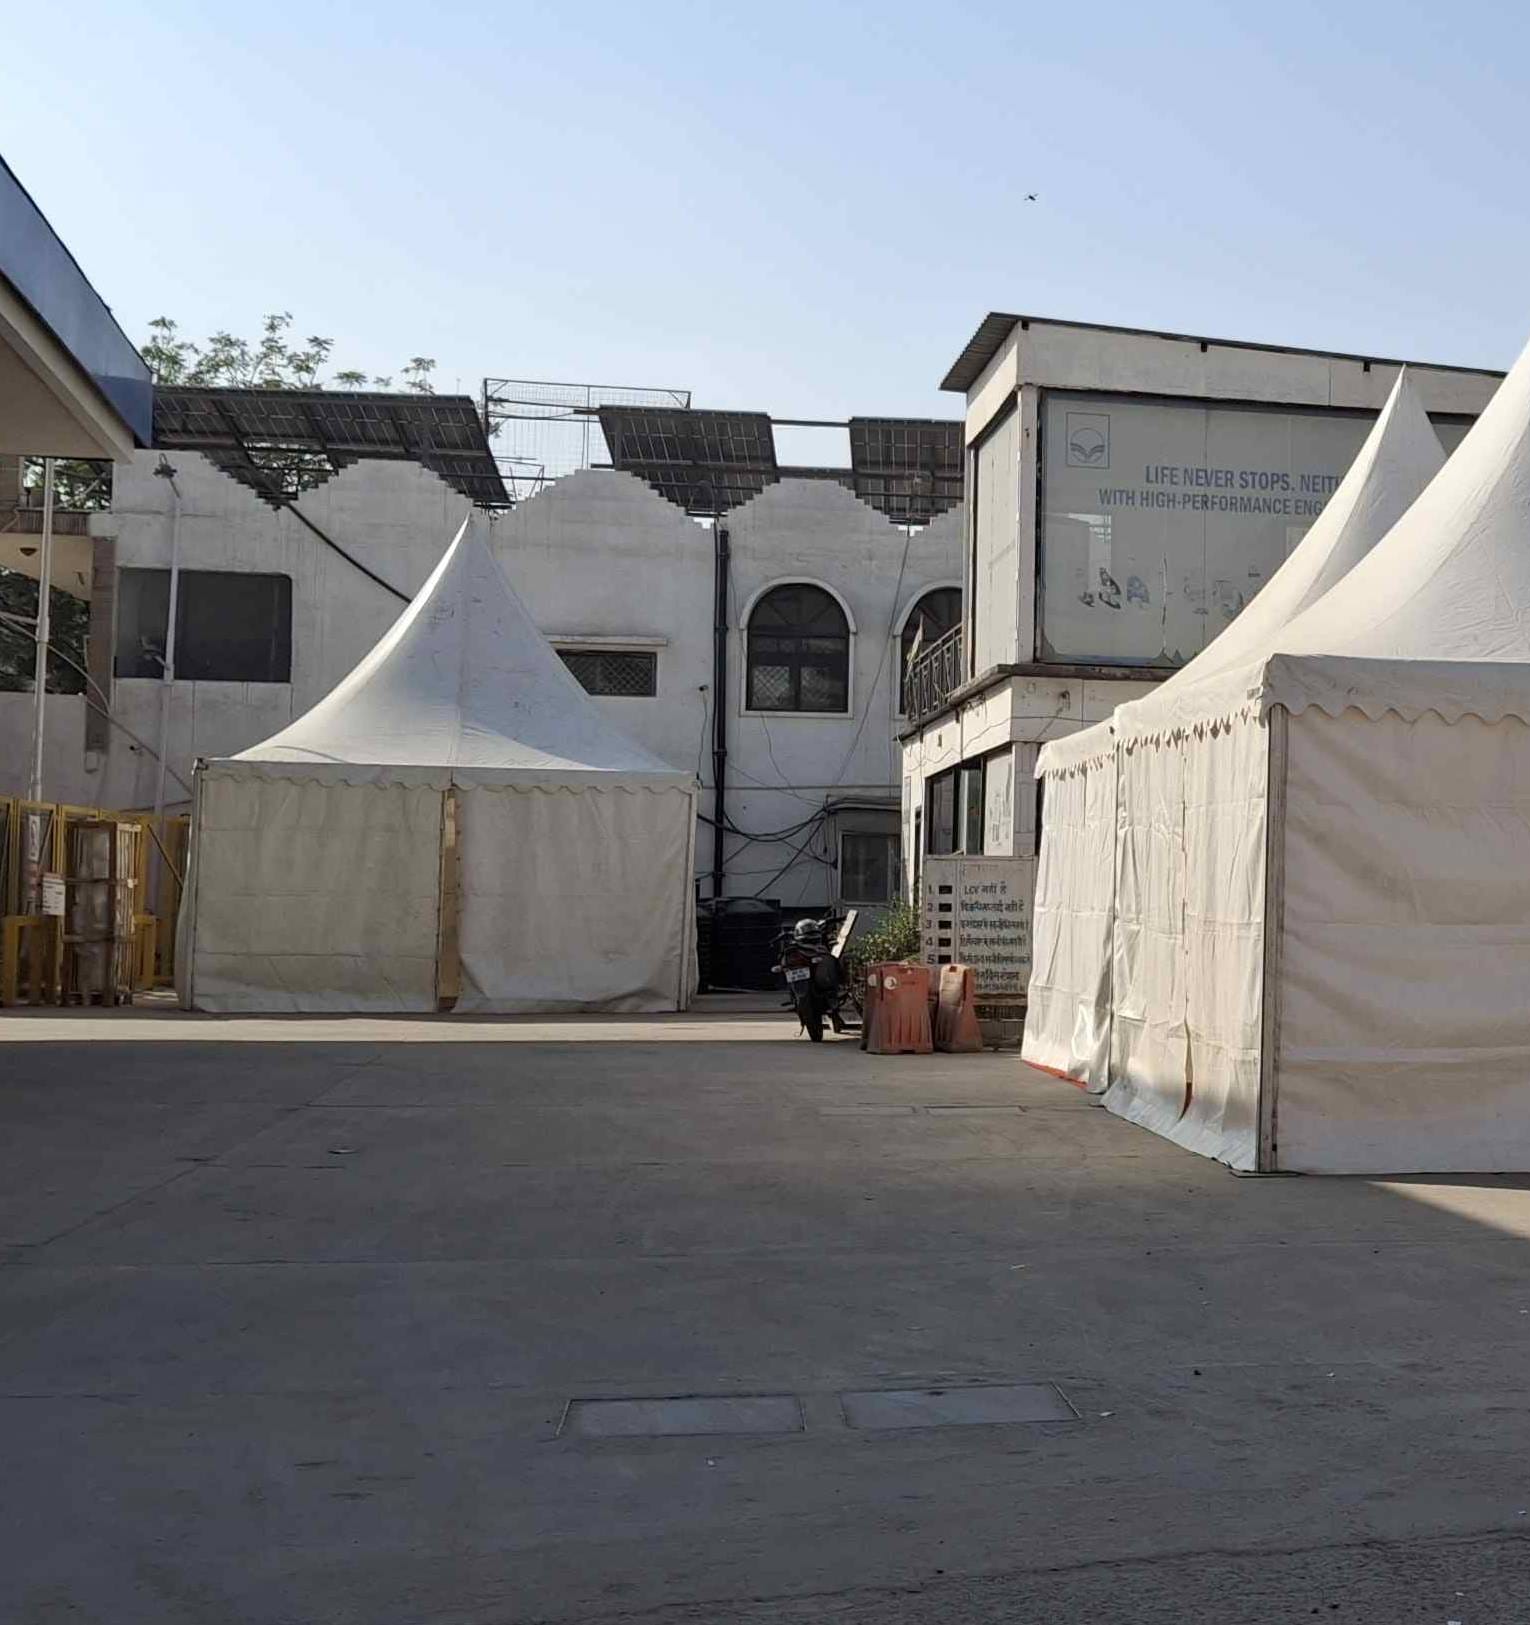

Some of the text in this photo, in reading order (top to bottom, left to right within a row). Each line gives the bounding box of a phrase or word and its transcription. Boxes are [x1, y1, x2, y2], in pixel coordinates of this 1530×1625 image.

[1145, 466, 1180, 486] LIFE
[1183, 467, 1235, 488] NEVER
[1239, 470, 1296, 492] STOPS.
[1098, 488, 1135, 506] WITH
[1140, 491, 1292, 515] HIGH-PERFORMANCE
